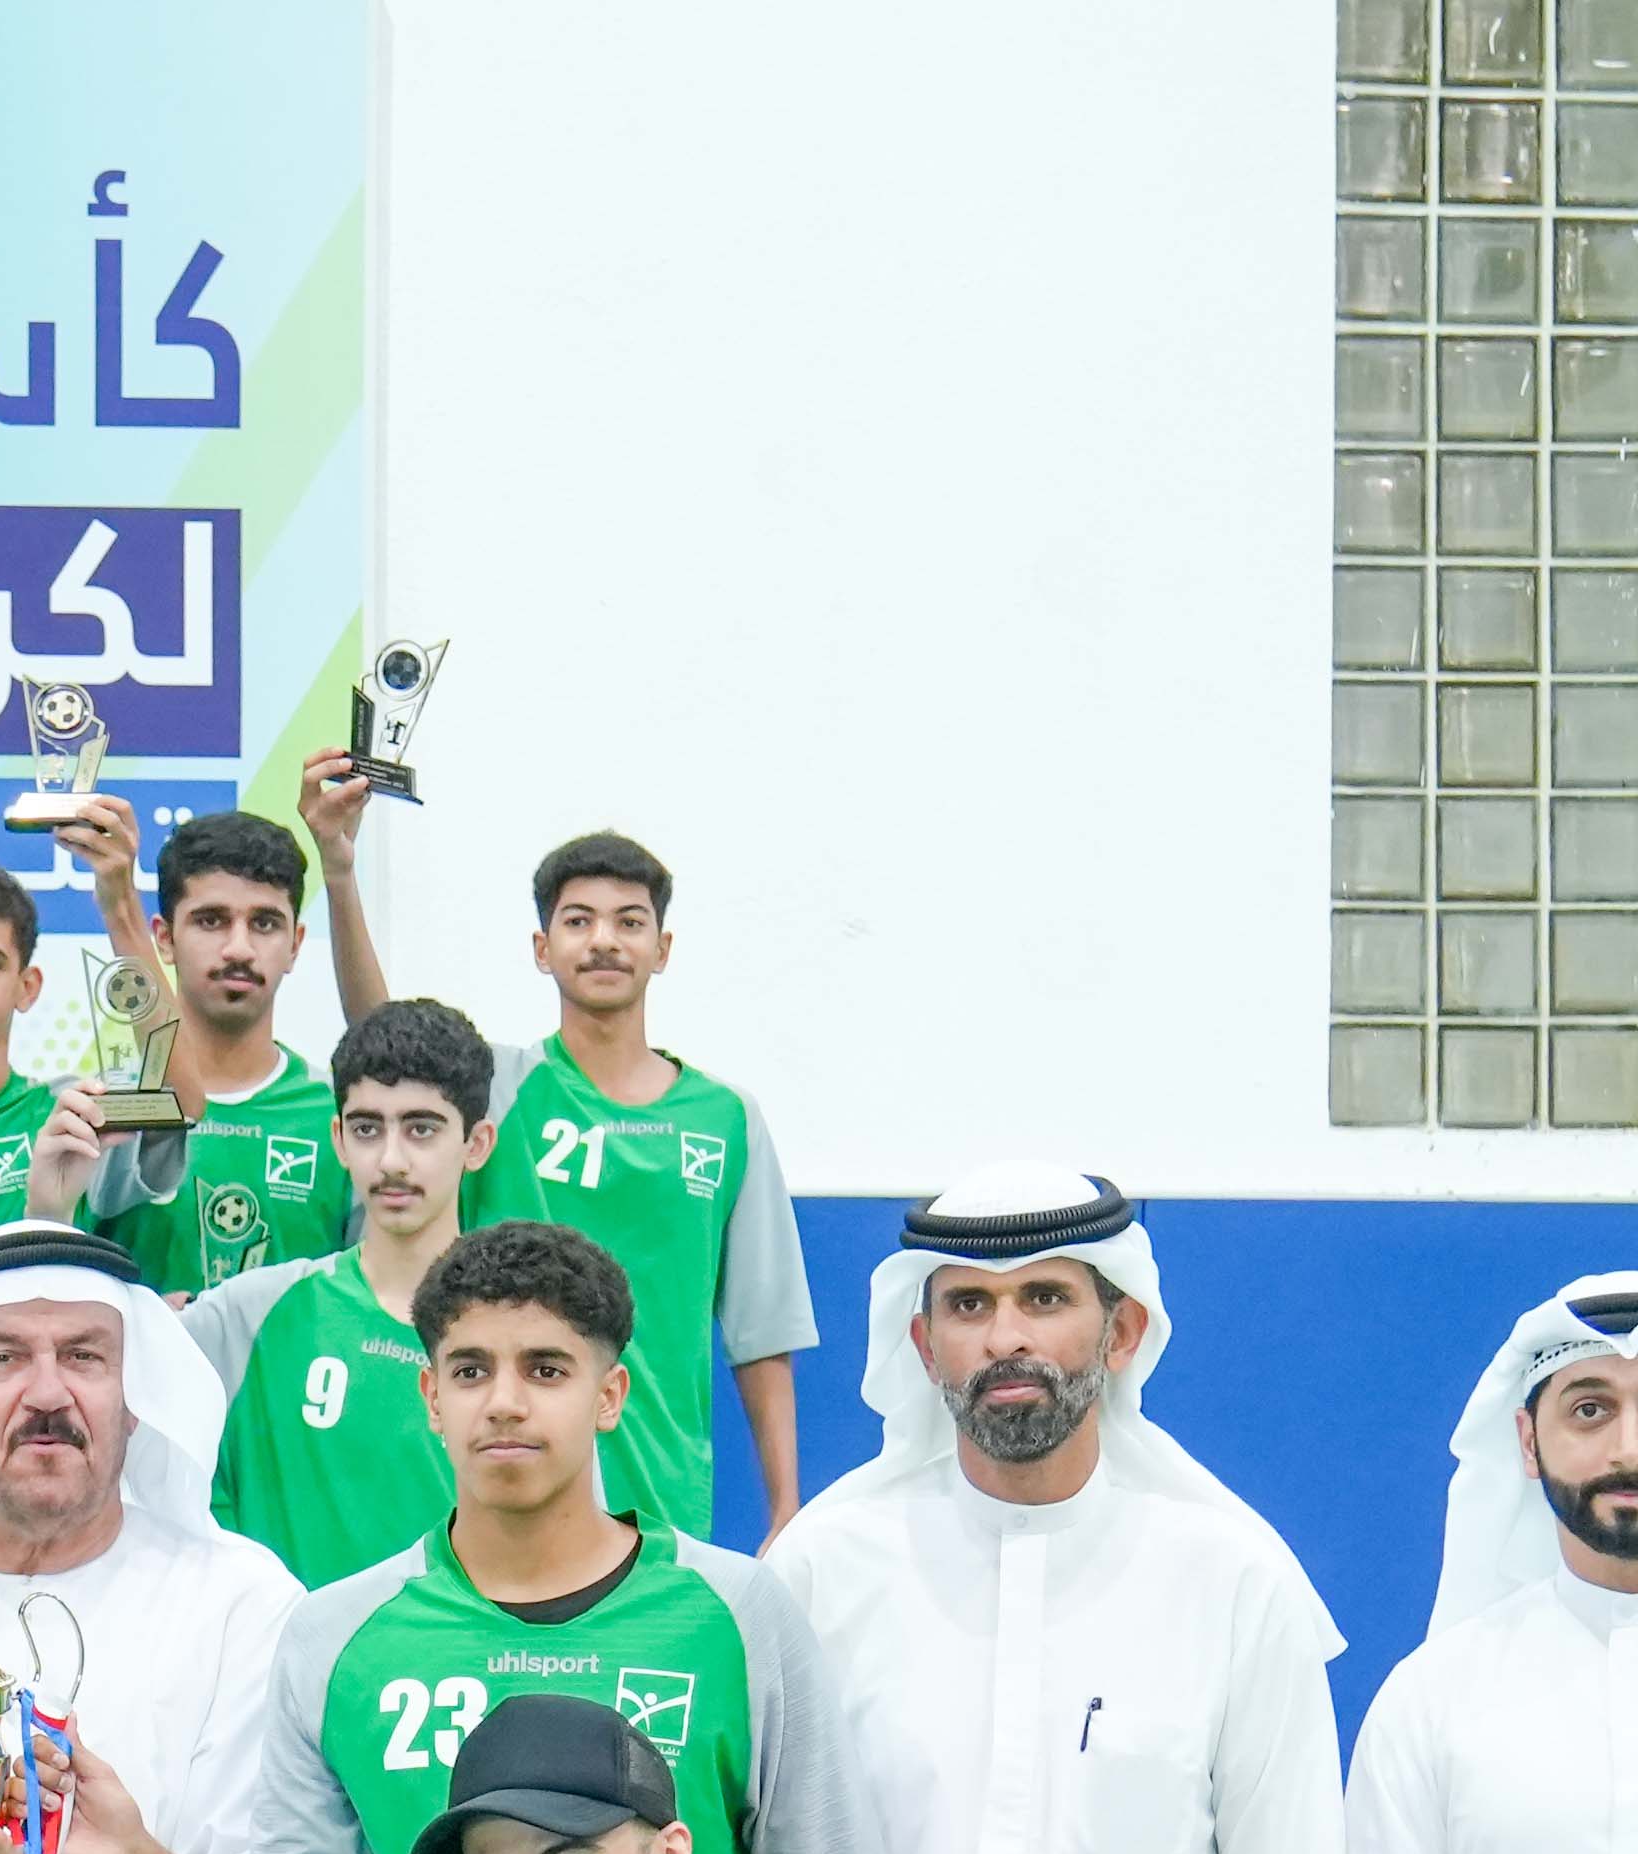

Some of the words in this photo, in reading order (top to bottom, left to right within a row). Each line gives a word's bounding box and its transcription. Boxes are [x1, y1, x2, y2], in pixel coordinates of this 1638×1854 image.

[535, 1116, 607, 1190] 21
[360, 1337, 432, 1369] uhlspo
[301, 1355, 349, 1430] 9
[486, 1651, 601, 1678] uhlsport
[378, 1675, 489, 1772] 23
